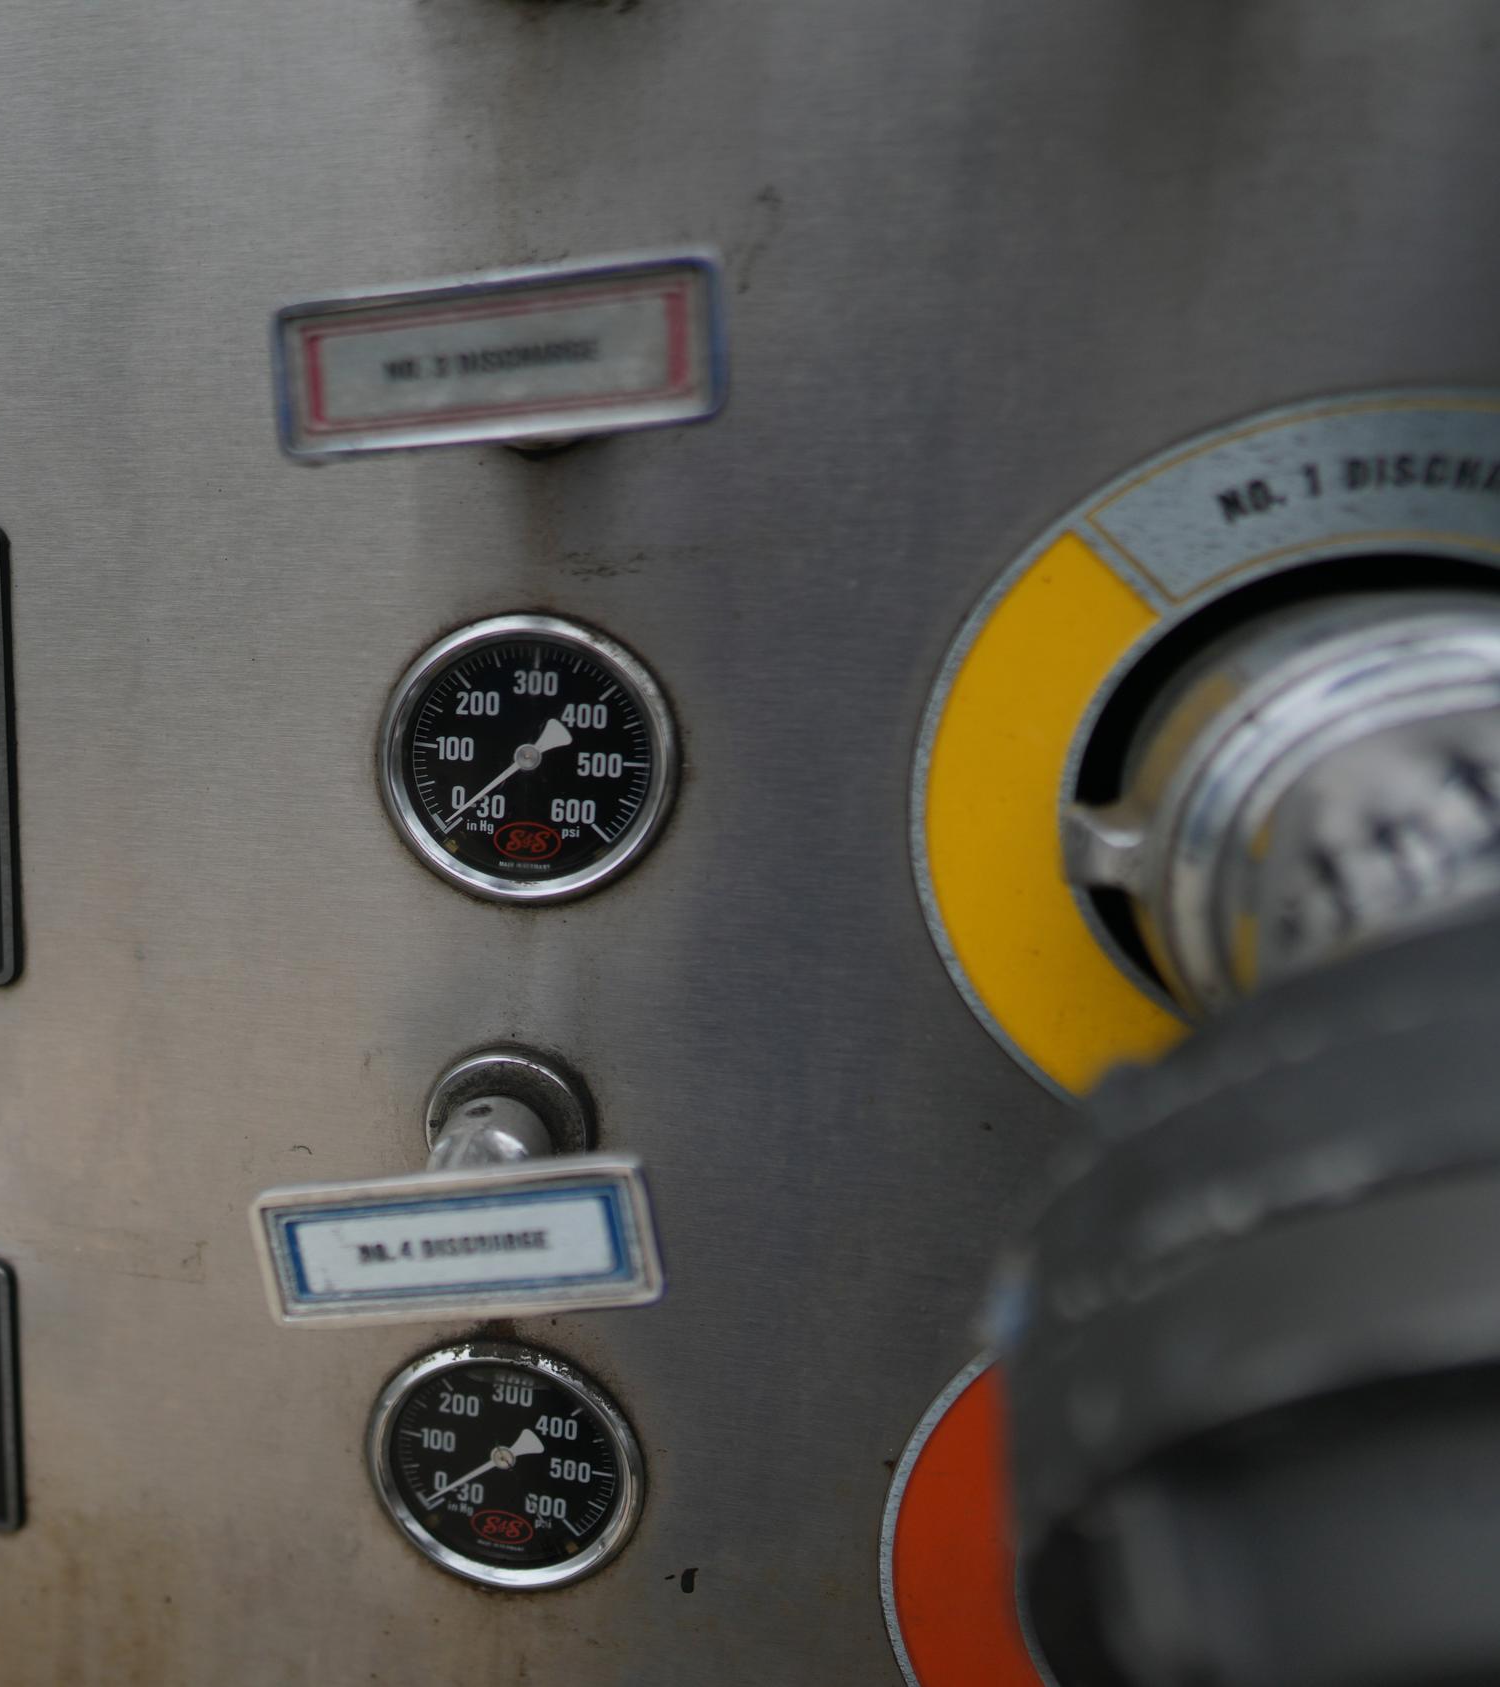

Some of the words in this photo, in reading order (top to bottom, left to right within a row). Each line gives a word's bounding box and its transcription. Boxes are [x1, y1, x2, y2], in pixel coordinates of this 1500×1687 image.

[1216, 478, 1286, 523] NO.
[1303, 463, 1322, 497] 1
[513, 670, 558, 696] 300
[456, 691, 499, 716] 200
[561, 704, 607, 729] 400
[436, 736, 474, 761] 100
[577, 753, 622, 778] 500
[551, 799, 596, 824] 600
[466, 820, 477, 831] in
[480, 821, 494, 835] Hg
[561, 826, 580, 839] psi
[439, 1392, 479, 1417] 200
[492, 1384, 533, 1407] 300
[421, 1428, 456, 1452] 100
[535, 1415, 578, 1440] 400
[550, 1458, 591, 1483] 500
[525, 1493, 566, 1519] 600
